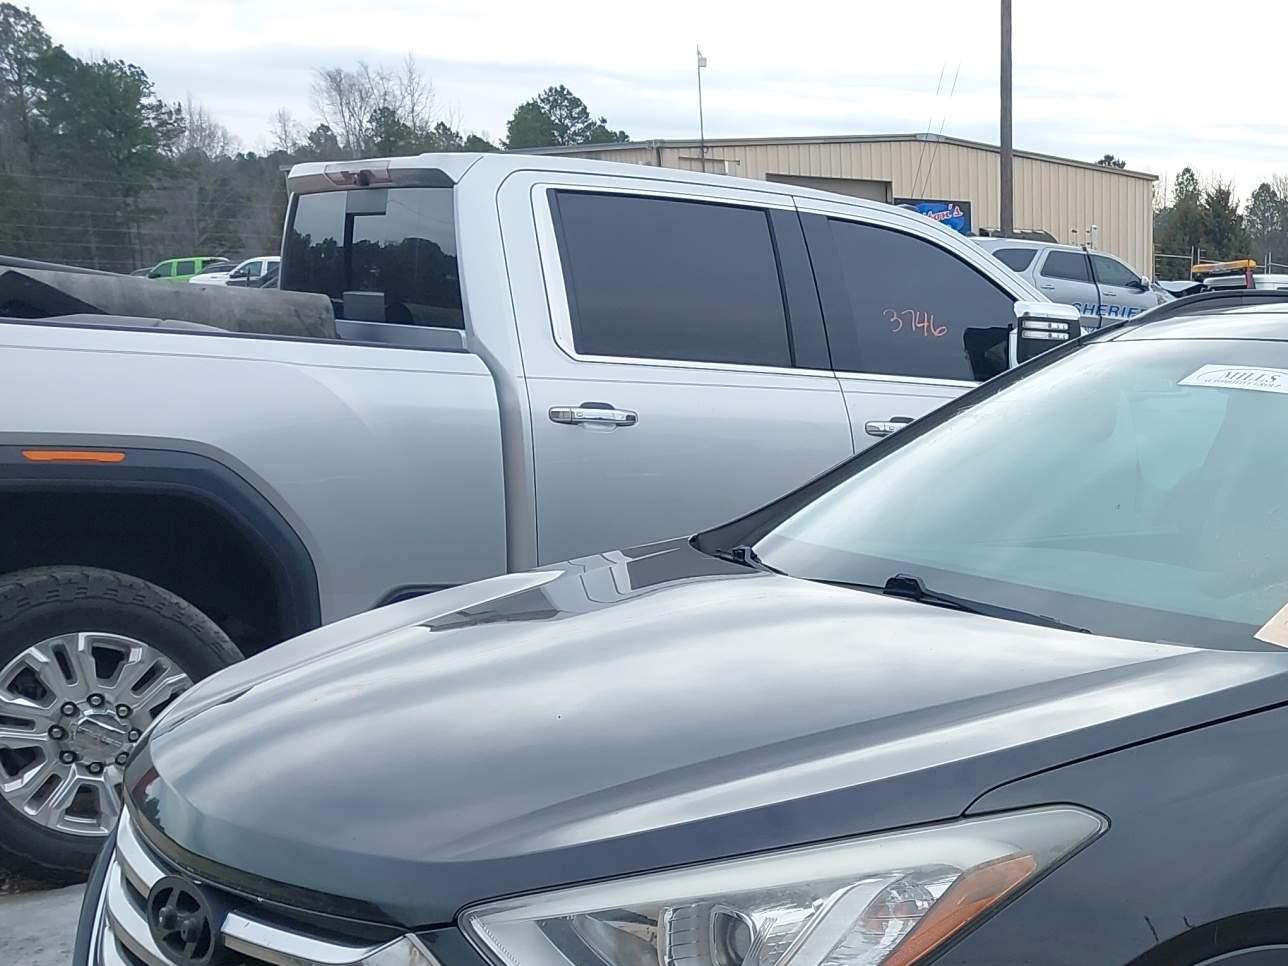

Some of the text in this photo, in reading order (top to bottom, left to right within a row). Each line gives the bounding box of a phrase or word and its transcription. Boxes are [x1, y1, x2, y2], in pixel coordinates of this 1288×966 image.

[1072, 302, 1147, 318] SHERIF
[882, 308, 948, 337] 3746
[1219, 371, 1282, 383] MILLS
